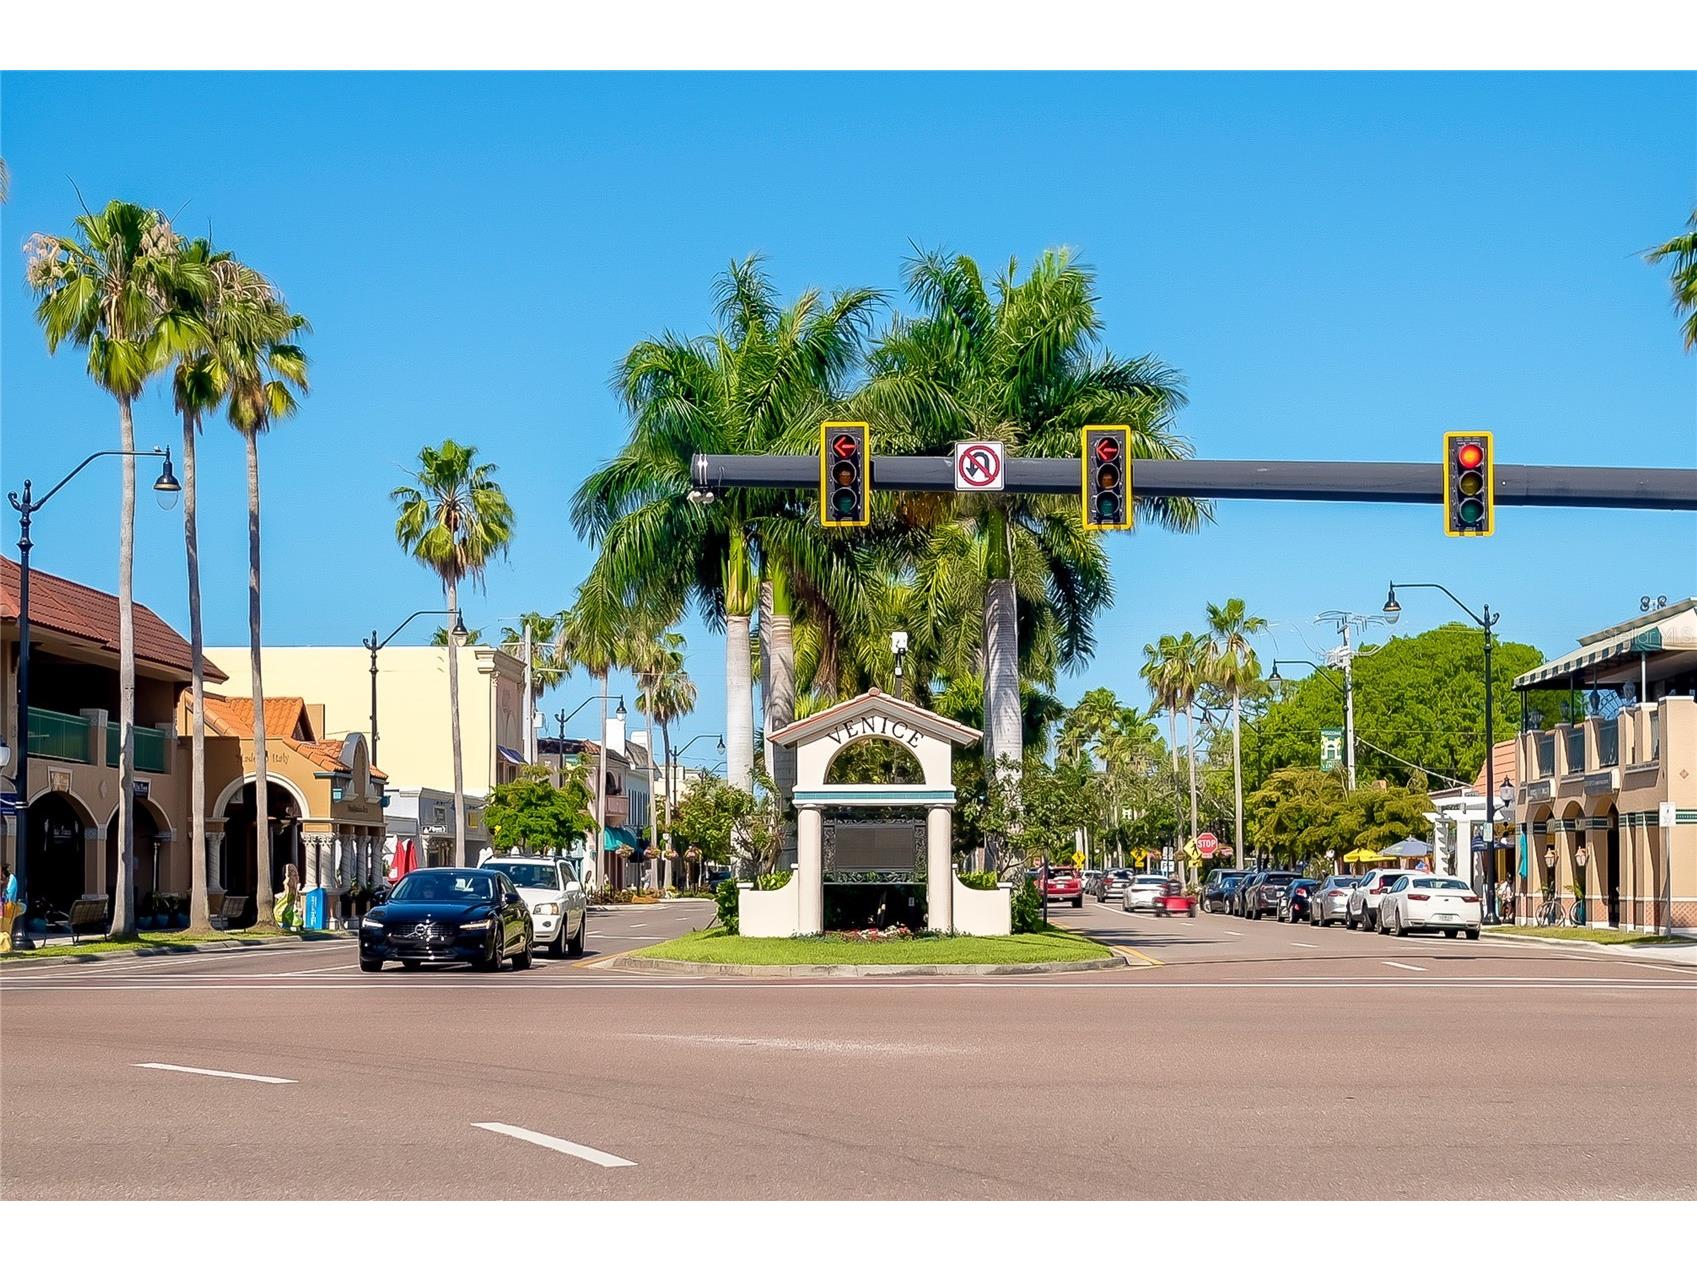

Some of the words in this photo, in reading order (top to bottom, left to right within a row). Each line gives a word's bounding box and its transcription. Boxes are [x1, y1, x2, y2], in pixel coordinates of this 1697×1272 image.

[826, 715, 925, 748] VENICE
[272, 752, 289, 765] Italy
[1198, 839, 1216, 848] STOP
